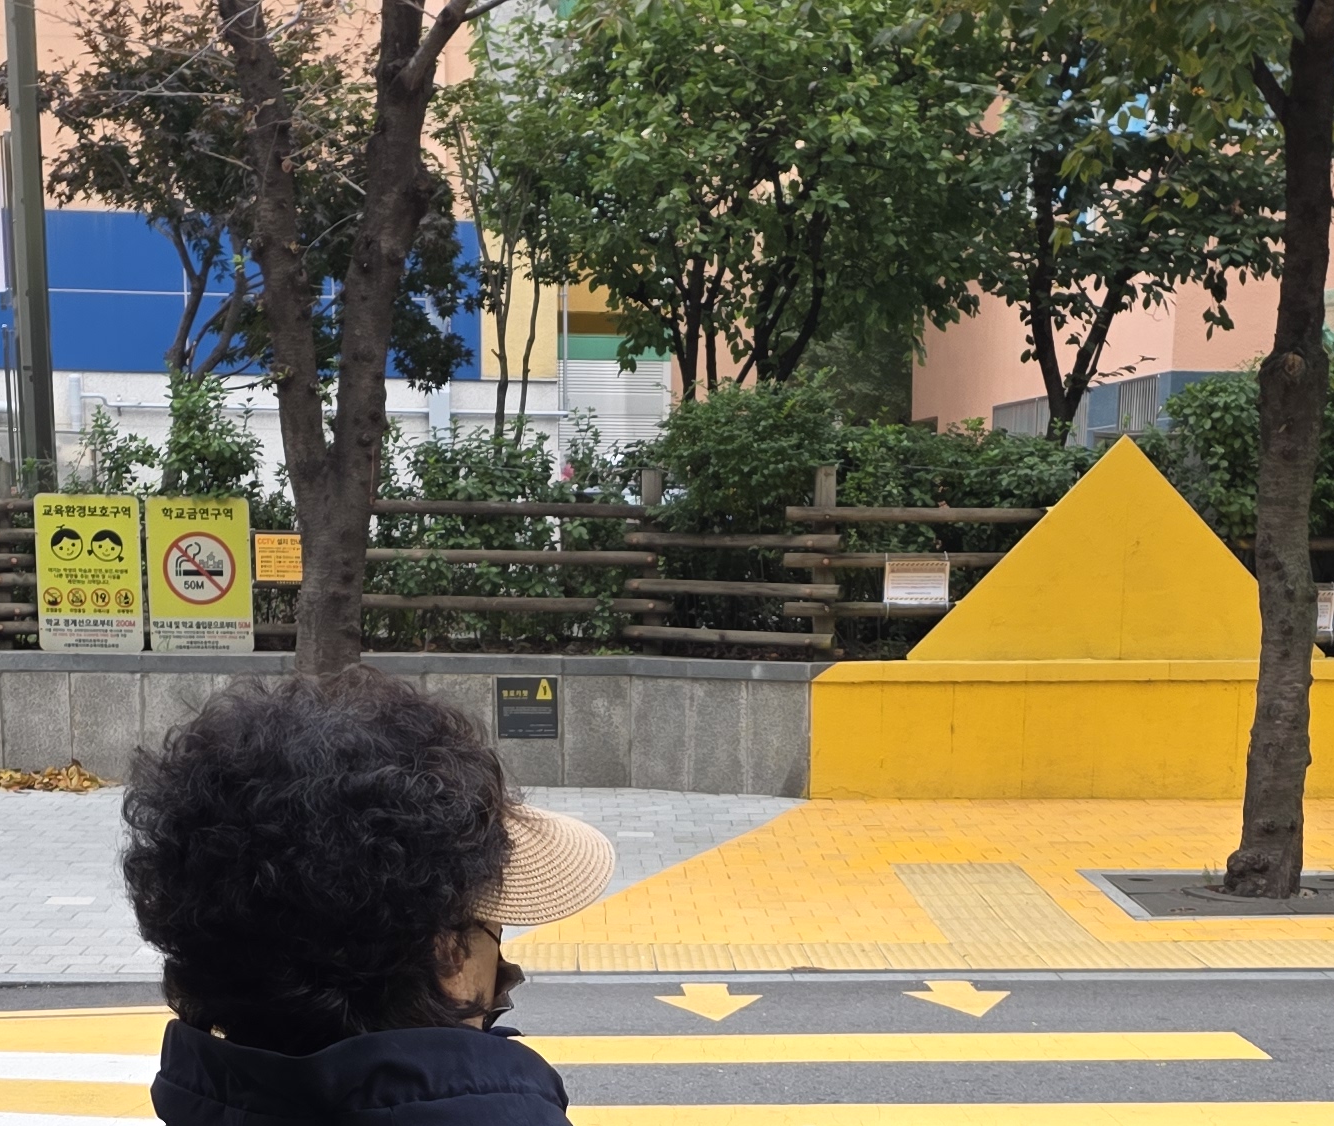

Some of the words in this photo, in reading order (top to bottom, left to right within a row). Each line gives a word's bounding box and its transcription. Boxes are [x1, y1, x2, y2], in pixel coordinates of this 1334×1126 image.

[42, 505, 131, 519] 교육환경보호구역
[161, 507, 233, 521] 학교금연구역
[183, 580, 205, 590] 50M
[95, 592, 107, 603] 19
[63, 619, 113, 627] 경계선으로부터
[152, 621, 165, 629] 학교
[181, 621, 194, 629] 학교
[195, 621, 237, 629] 출입문으로부터
